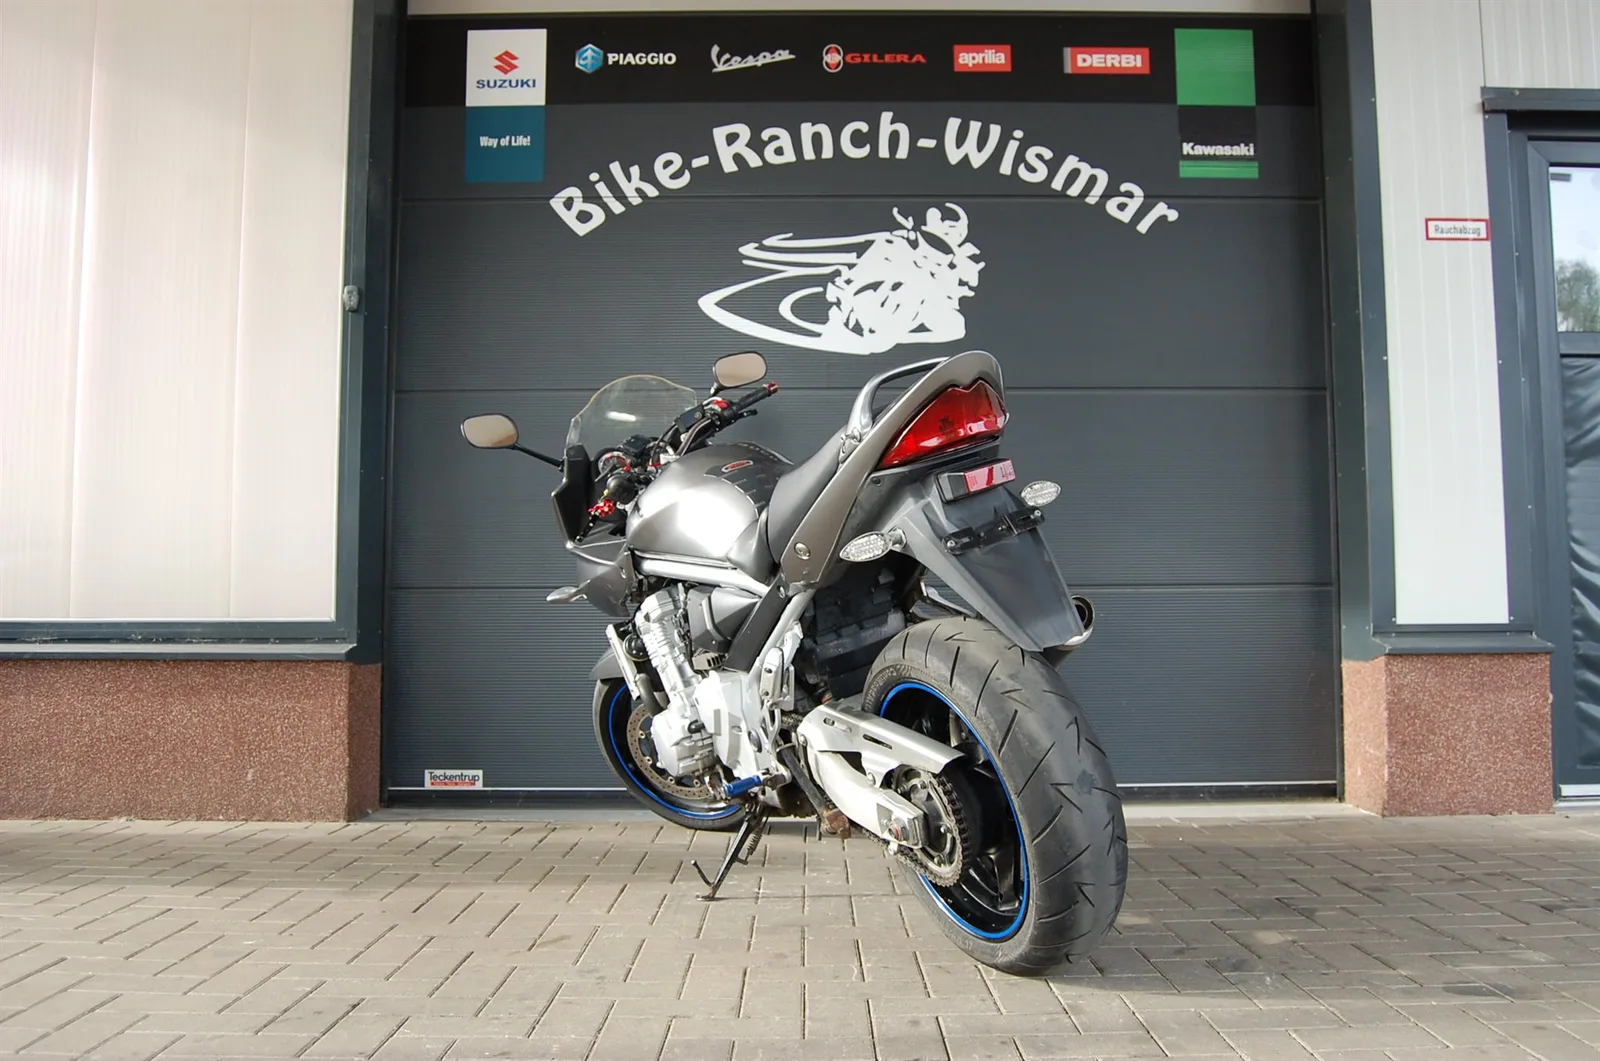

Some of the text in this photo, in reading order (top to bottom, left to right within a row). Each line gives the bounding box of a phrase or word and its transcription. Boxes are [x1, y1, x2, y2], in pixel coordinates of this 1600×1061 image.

[607, 52, 677, 65] PIAGGIO
[711, 44, 796, 72] Vespa
[845, 52, 927, 64] GILERA
[958, 49, 1006, 67] aprilia
[1076, 54, 1142, 67] DERBI
[476, 78, 536, 89] SUZUKI
[479, 135, 531, 148] Way of Life!
[1181, 142, 1255, 156] Kawasaki
[428, 771, 480, 786] Teckentrup
